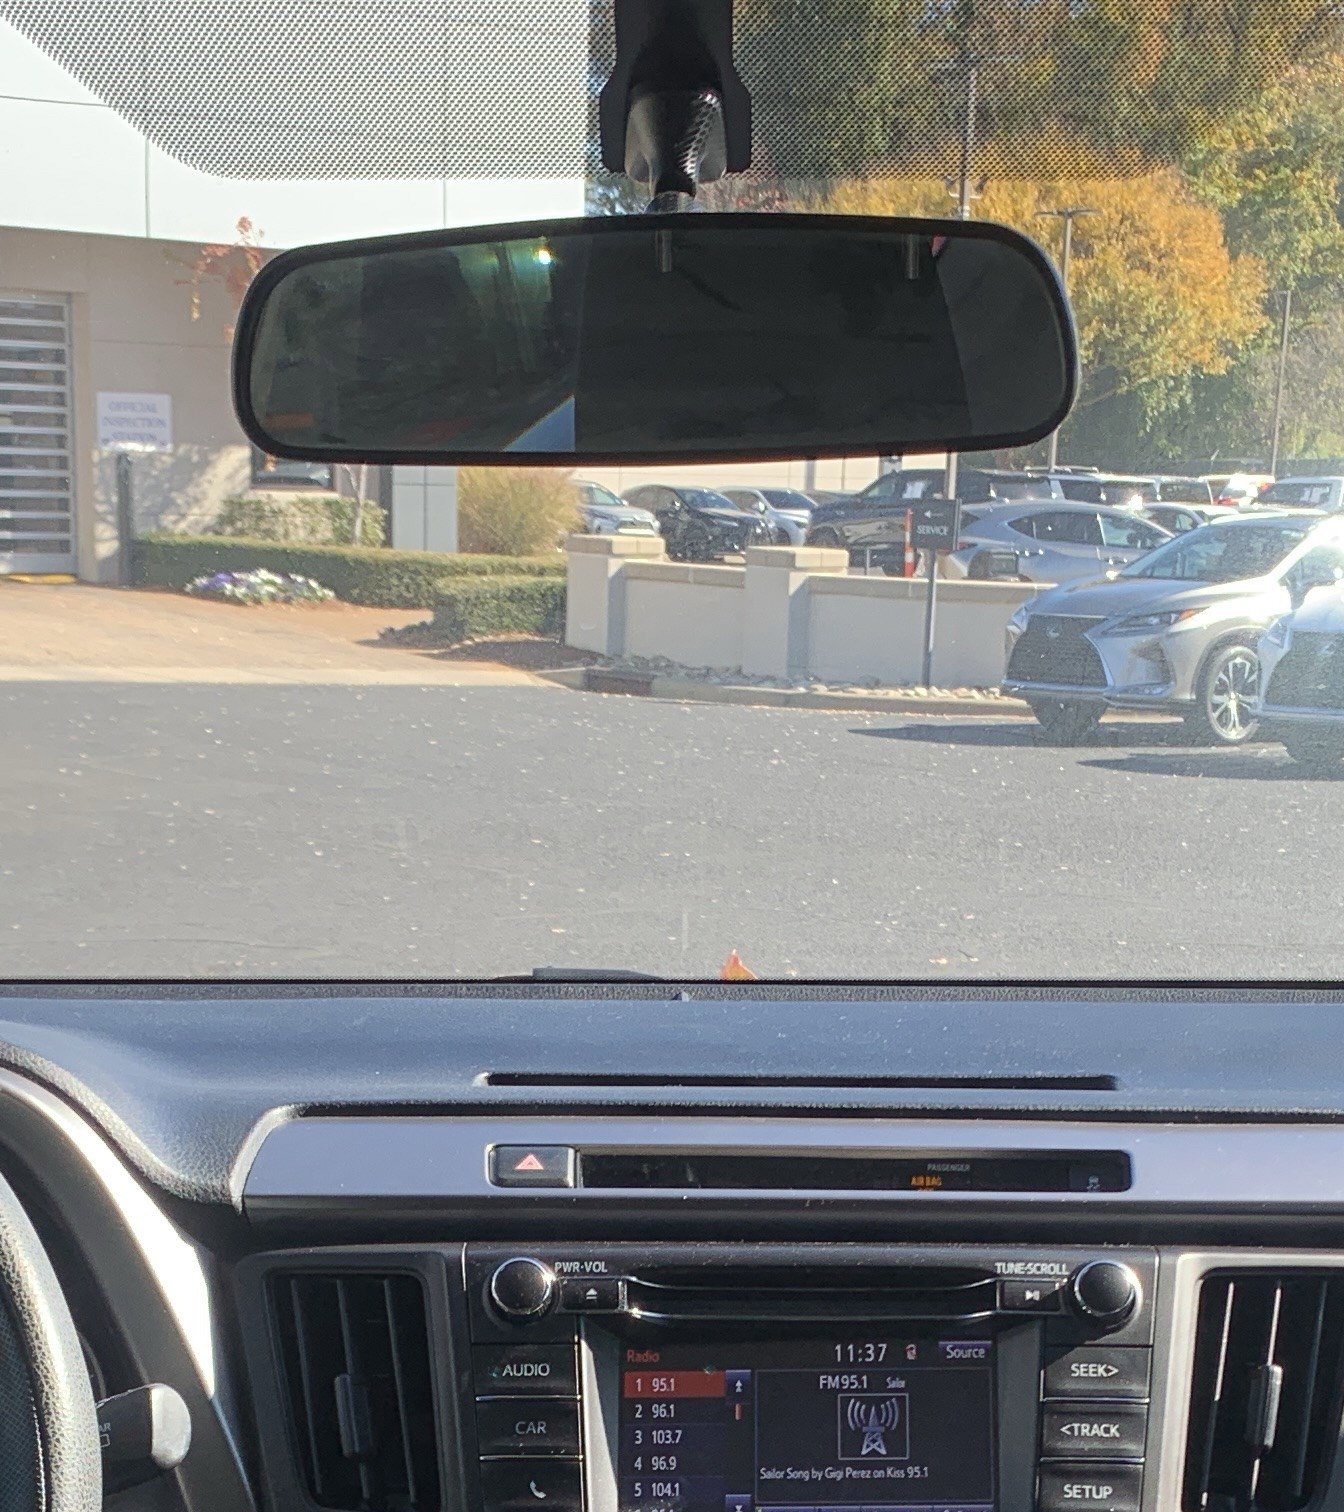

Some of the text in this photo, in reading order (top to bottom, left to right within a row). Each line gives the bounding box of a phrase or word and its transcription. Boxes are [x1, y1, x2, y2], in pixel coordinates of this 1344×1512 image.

[627, 1350, 659, 1362] Radio
[834, 1344, 888, 1362] 11:37
[945, 1346, 985, 1359] Source
[502, 1363, 550, 1377] AUDIO
[636, 1378, 675, 1392] 1 95.1
[635, 1404, 675, 1418] 2 96.1
[515, 1421, 547, 1435] CAR
[635, 1430, 683, 1444] 3 103.7
[634, 1456, 677, 1471] 4 96.9
[760, 1466, 929, 1481] Sailor Song by Gigi Perez on Kiss 95.1
[634, 1482, 680, 1497] 5 104.1
[1063, 1485, 1113, 1499] SETUP
